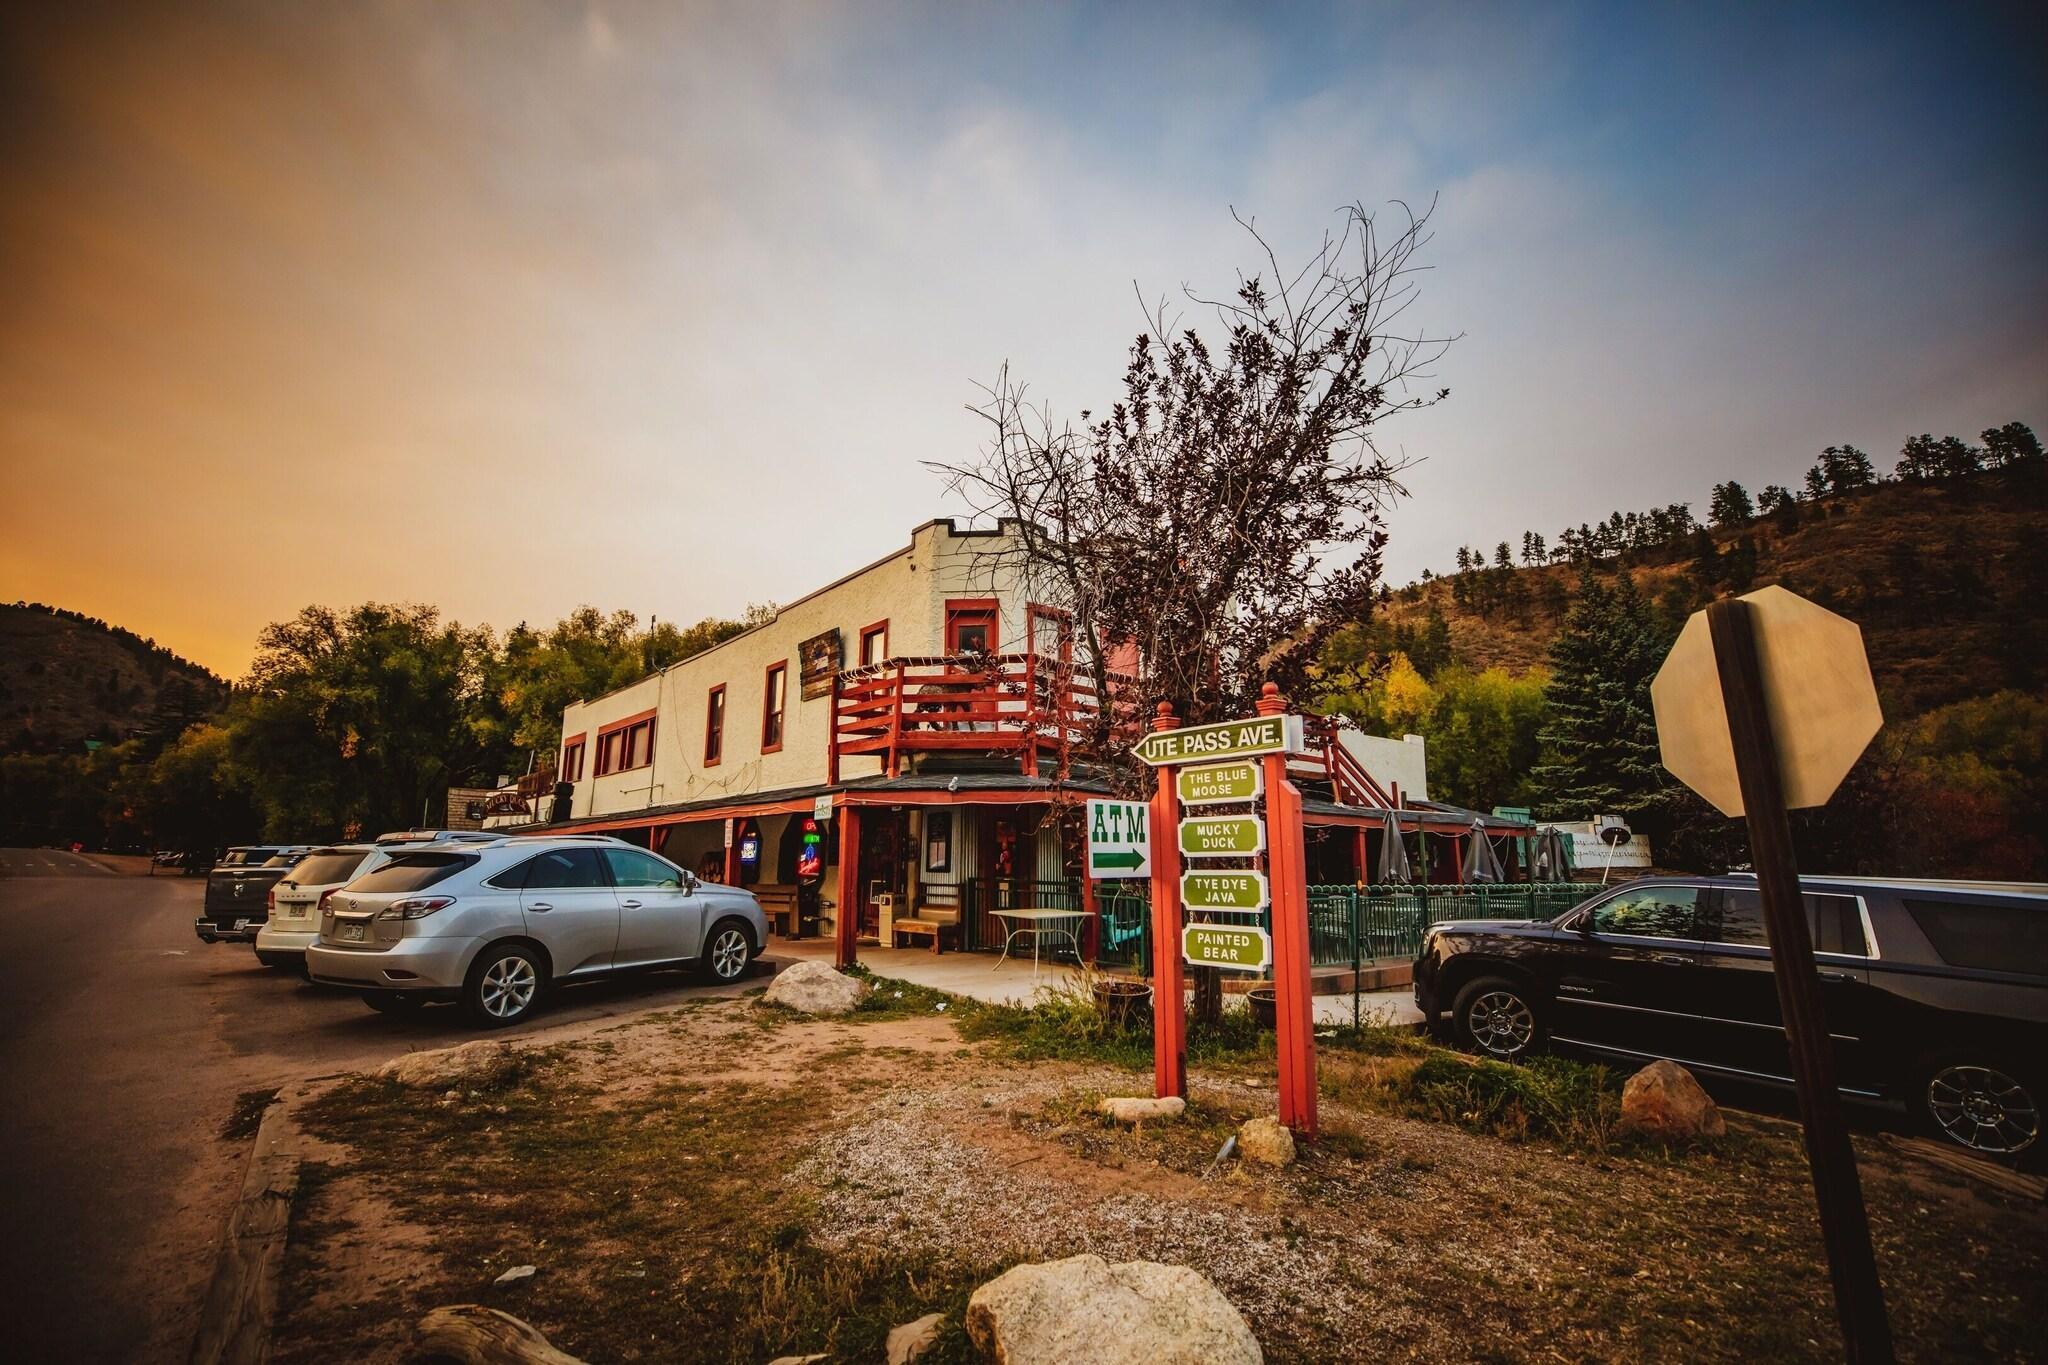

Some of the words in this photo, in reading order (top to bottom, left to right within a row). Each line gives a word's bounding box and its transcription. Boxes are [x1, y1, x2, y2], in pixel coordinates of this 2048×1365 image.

[1145, 737, 1178, 759] UTE
[1183, 730, 1231, 754] PASS
[1237, 723, 1280, 747] AVE.
[1189, 772, 1211, 784] THE
[1216, 768, 1248, 781] BLUE
[1192, 784, 1232, 798] MOOSE
[1092, 803, 1146, 844] ATM
[1196, 824, 1240, 837] MUCKY
[1202, 837, 1236, 849] DUCK
[1195, 878, 1218, 890] TYE
[1222, 878, 1248, 890] DYE
[1205, 891, 1236, 903] JAVA
[1197, 932, 1250, 947] PAINTED
[1203, 947, 1239, 961] BEAR
